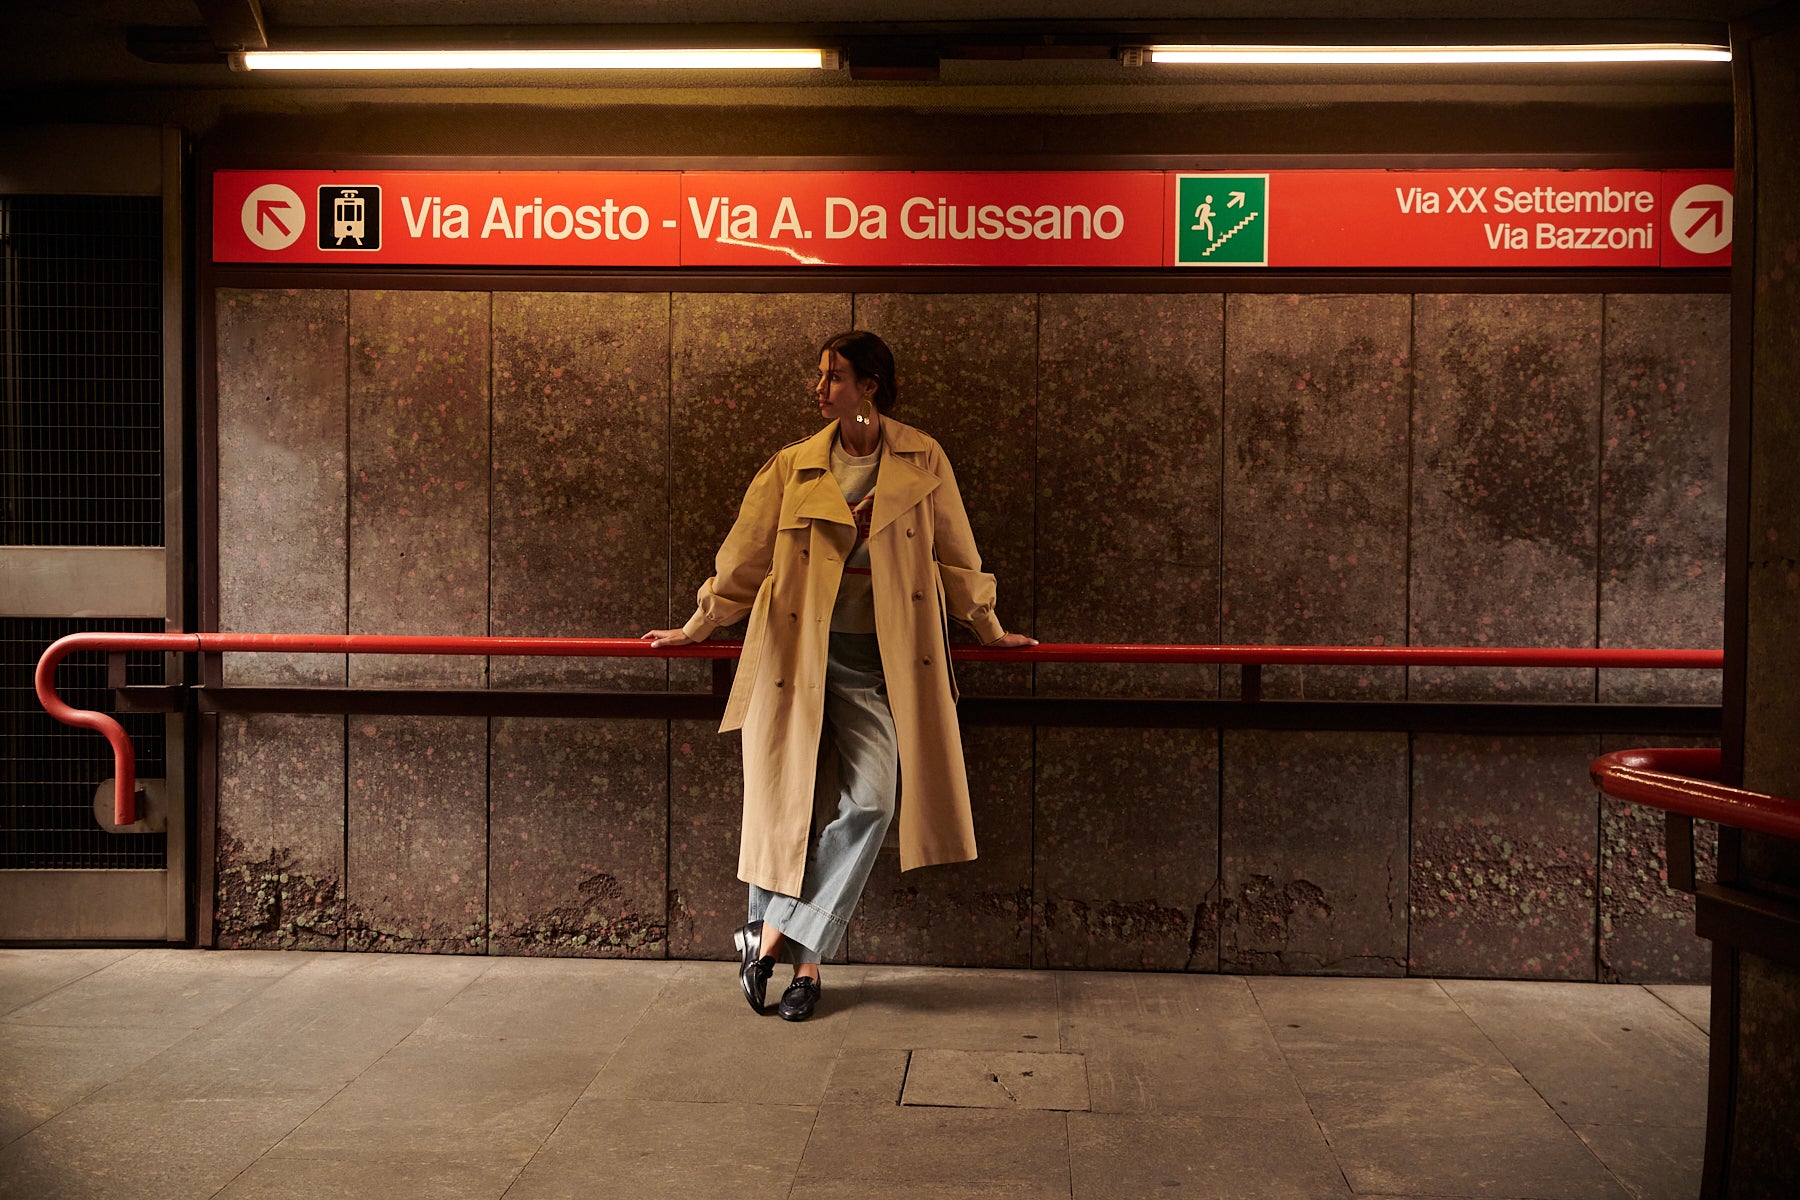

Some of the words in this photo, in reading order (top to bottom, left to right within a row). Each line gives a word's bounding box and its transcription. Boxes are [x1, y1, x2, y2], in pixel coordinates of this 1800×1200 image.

[1395, 187, 1440, 214] Via
[1446, 186, 1488, 214] XX
[1493, 186, 1654, 214] Settembre
[401, 196, 470, 239] Via
[481, 196, 650, 241] Ariosto
[662, 219, 677, 228] -
[687, 196, 758, 239] Via
[769, 196, 813, 239] A.
[825, 196, 888, 240] Da
[900, 196, 1125, 241] Giussano
[1483, 223, 1529, 250] Via
[1535, 222, 1653, 250] Bazzoni
